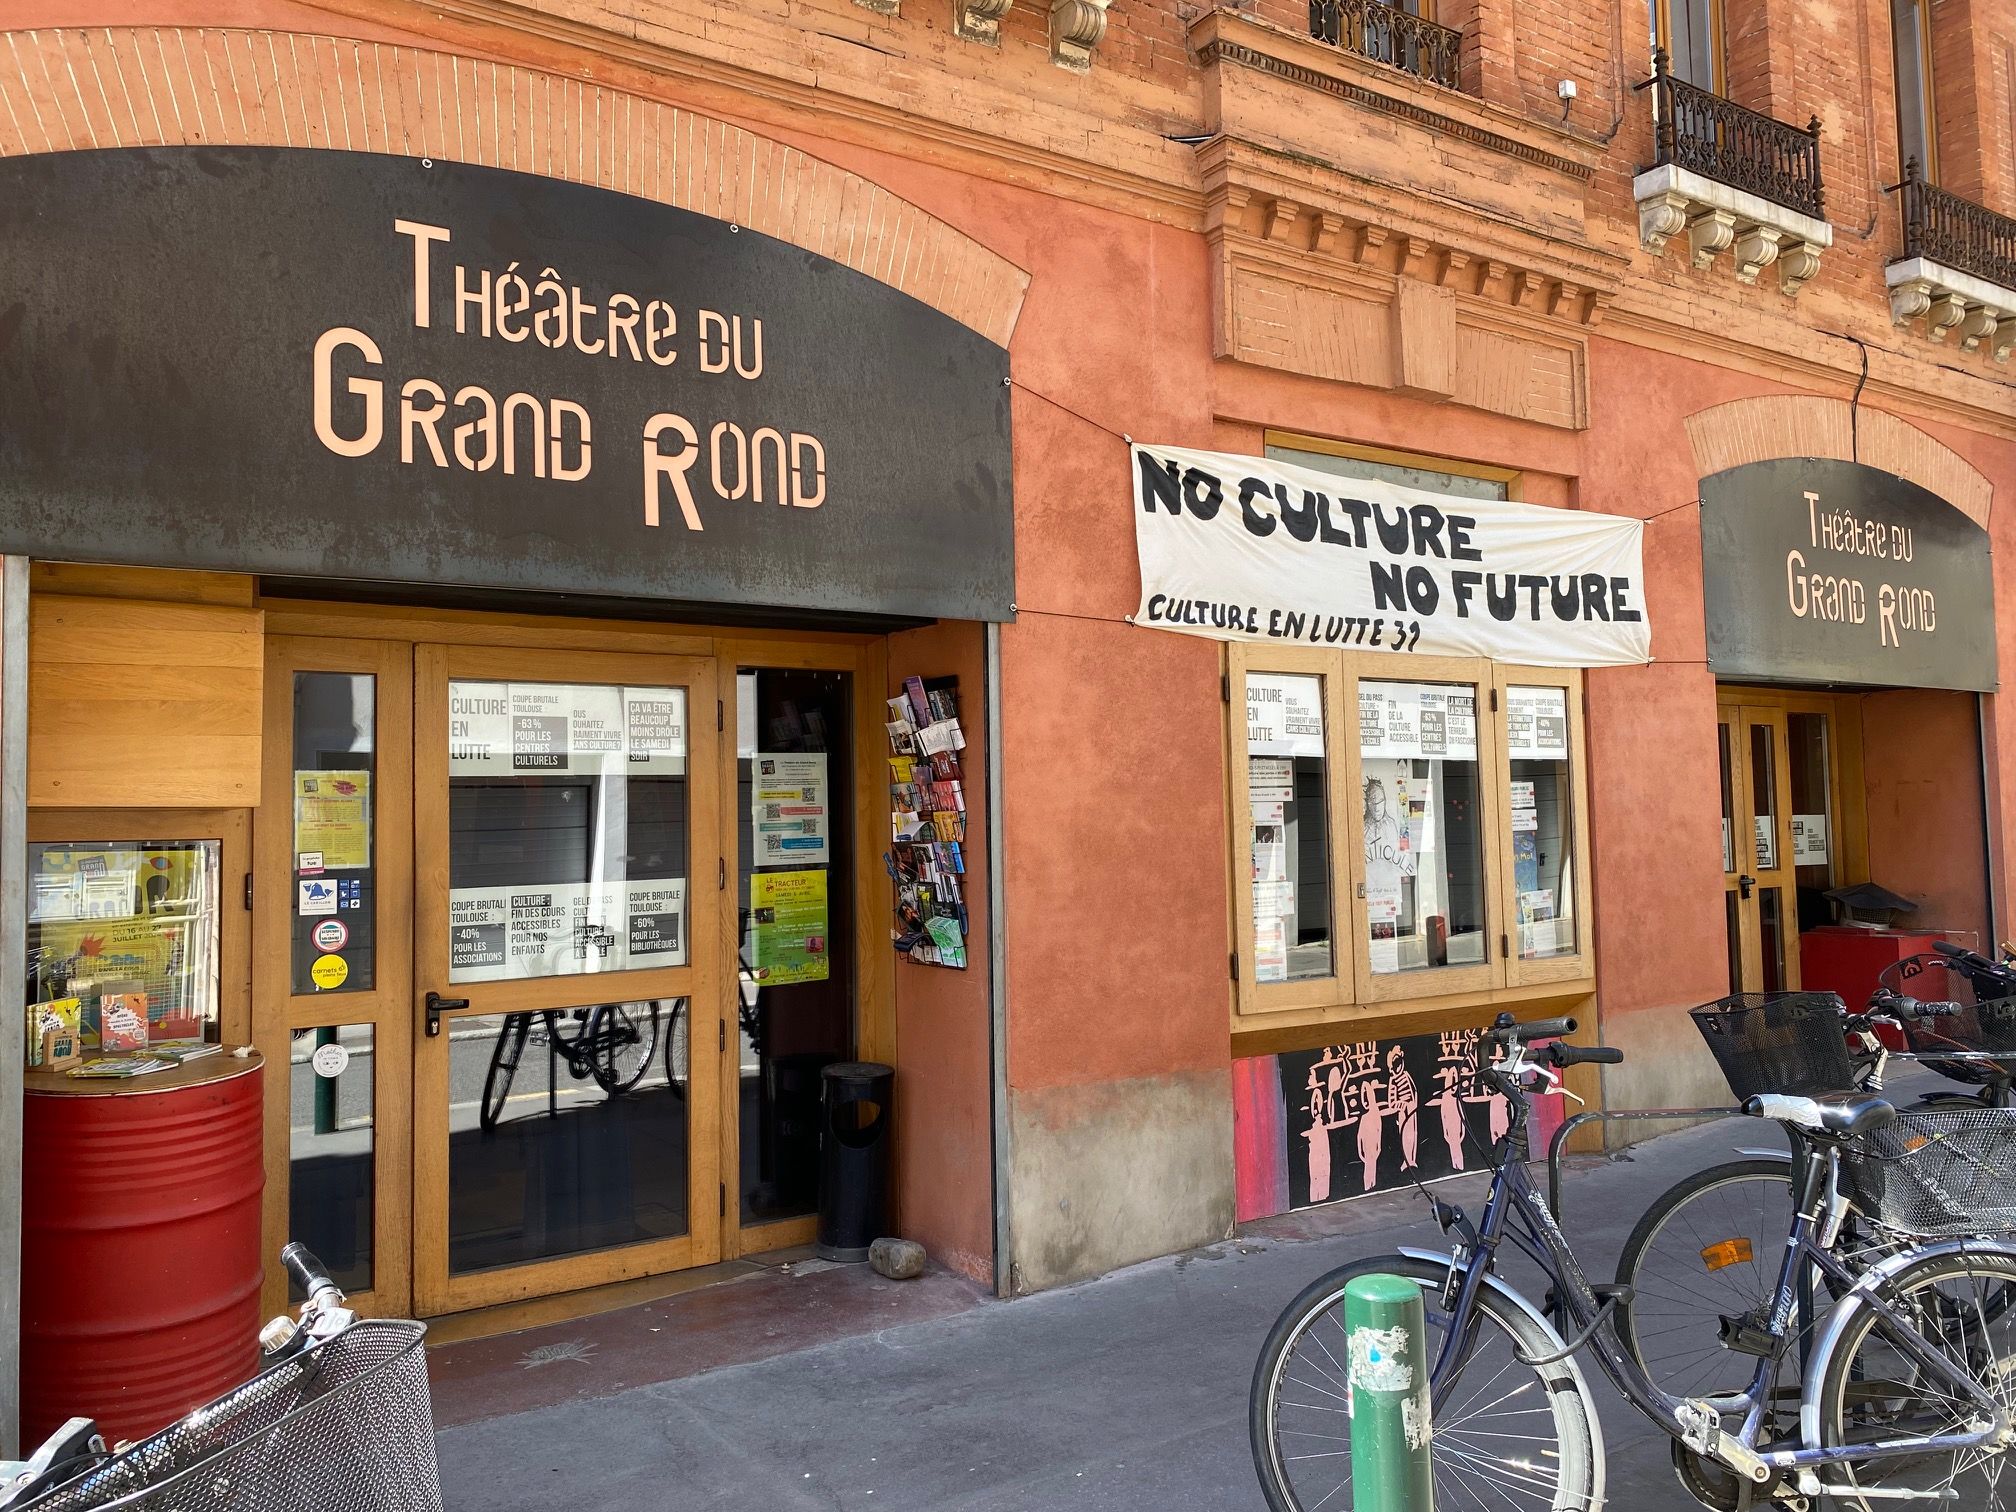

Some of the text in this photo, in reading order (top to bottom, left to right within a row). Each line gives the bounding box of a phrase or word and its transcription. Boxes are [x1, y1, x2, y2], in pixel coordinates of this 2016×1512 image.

[1137, 450, 1483, 562] NO CULTURE
[1369, 560, 1642, 623] NO FUTURE
[1147, 592, 1258, 634] CULTURE
[1268, 609, 1301, 639] EN
[1310, 613, 1384, 647] LUTTE
[512, 695, 559, 704] COUPE BRUTALE
[1246, 687, 1283, 703] CULTURE
[451, 697, 507, 715] CULTURE
[512, 704, 543, 713] TOULOUSE
[630, 701, 672, 717] ÇA VA ÊTRE
[1388, 699, 1397, 710] FIN
[573, 709, 587, 719] OUS
[1247, 706, 1259, 721] EN
[1388, 710, 1404, 720] DE LA
[572, 720, 605, 729] OUHAITEZ
[630, 714, 669, 725] BEAUCOUP
[451, 720, 469, 737] EN
[630, 725, 679, 737] MOINS DRÔLE
[1388, 722, 1412, 732] CULTURE
[515, 731, 552, 741] POUR LES
[573, 730, 622, 739] RAIMENT VIVRE
[1247, 727, 1273, 741] LUTTE
[1389, 733, 1420, 743] ACCESSIBLE
[515, 743, 551, 753] CENTRES
[573, 740, 589, 750] ANS
[630, 739, 670, 749] LE SAMEDI
[451, 743, 491, 760] LUTTE
[630, 751, 648, 761] SOIR
[515, 755, 559, 766] CULTURELS
[629, 890, 680, 902] COUPE BRUTALE
[451, 900, 476, 912] COUPE
[629, 902, 663, 913] TOULOUSE
[451, 911, 489, 923] TOULOUSE
[511, 906, 566, 919] FIN DES COURS
[511, 919, 561, 931] ACCESSIBLES
[634, 917, 655, 928] -60%
[112, 934, 143, 943] JUILLET
[456, 928, 480, 939] -40%
[511, 932, 548, 943] POUR NOS
[631, 930, 660, 941] POUR LES
[454, 941, 487, 953] POUR LES
[511, 944, 545, 956] ENFANTS
[631, 939, 677, 952] BIBLIOTHÈQUES
[453, 952, 503, 965] ASSOCIATIONS
